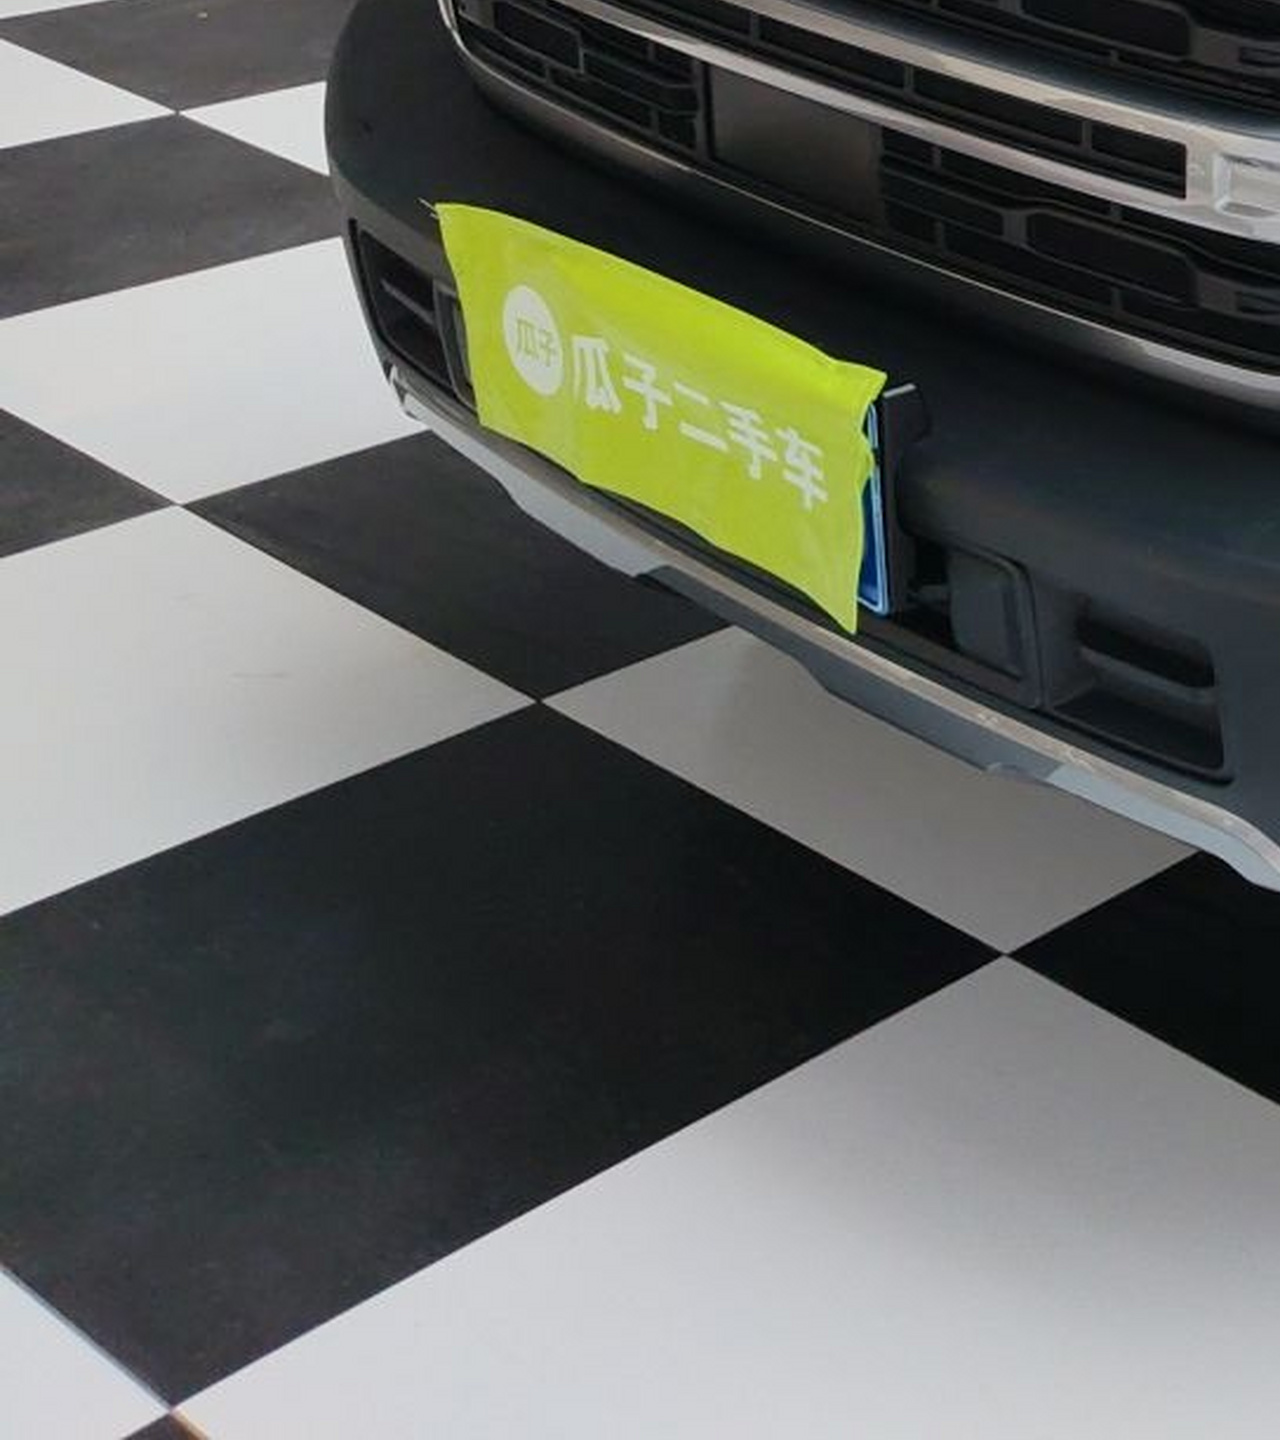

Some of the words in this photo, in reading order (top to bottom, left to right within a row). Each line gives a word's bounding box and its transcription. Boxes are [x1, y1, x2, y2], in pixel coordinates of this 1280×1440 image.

[515, 317, 558, 368] 瓜子
[571, 333, 828, 510] 瓜子二手车
